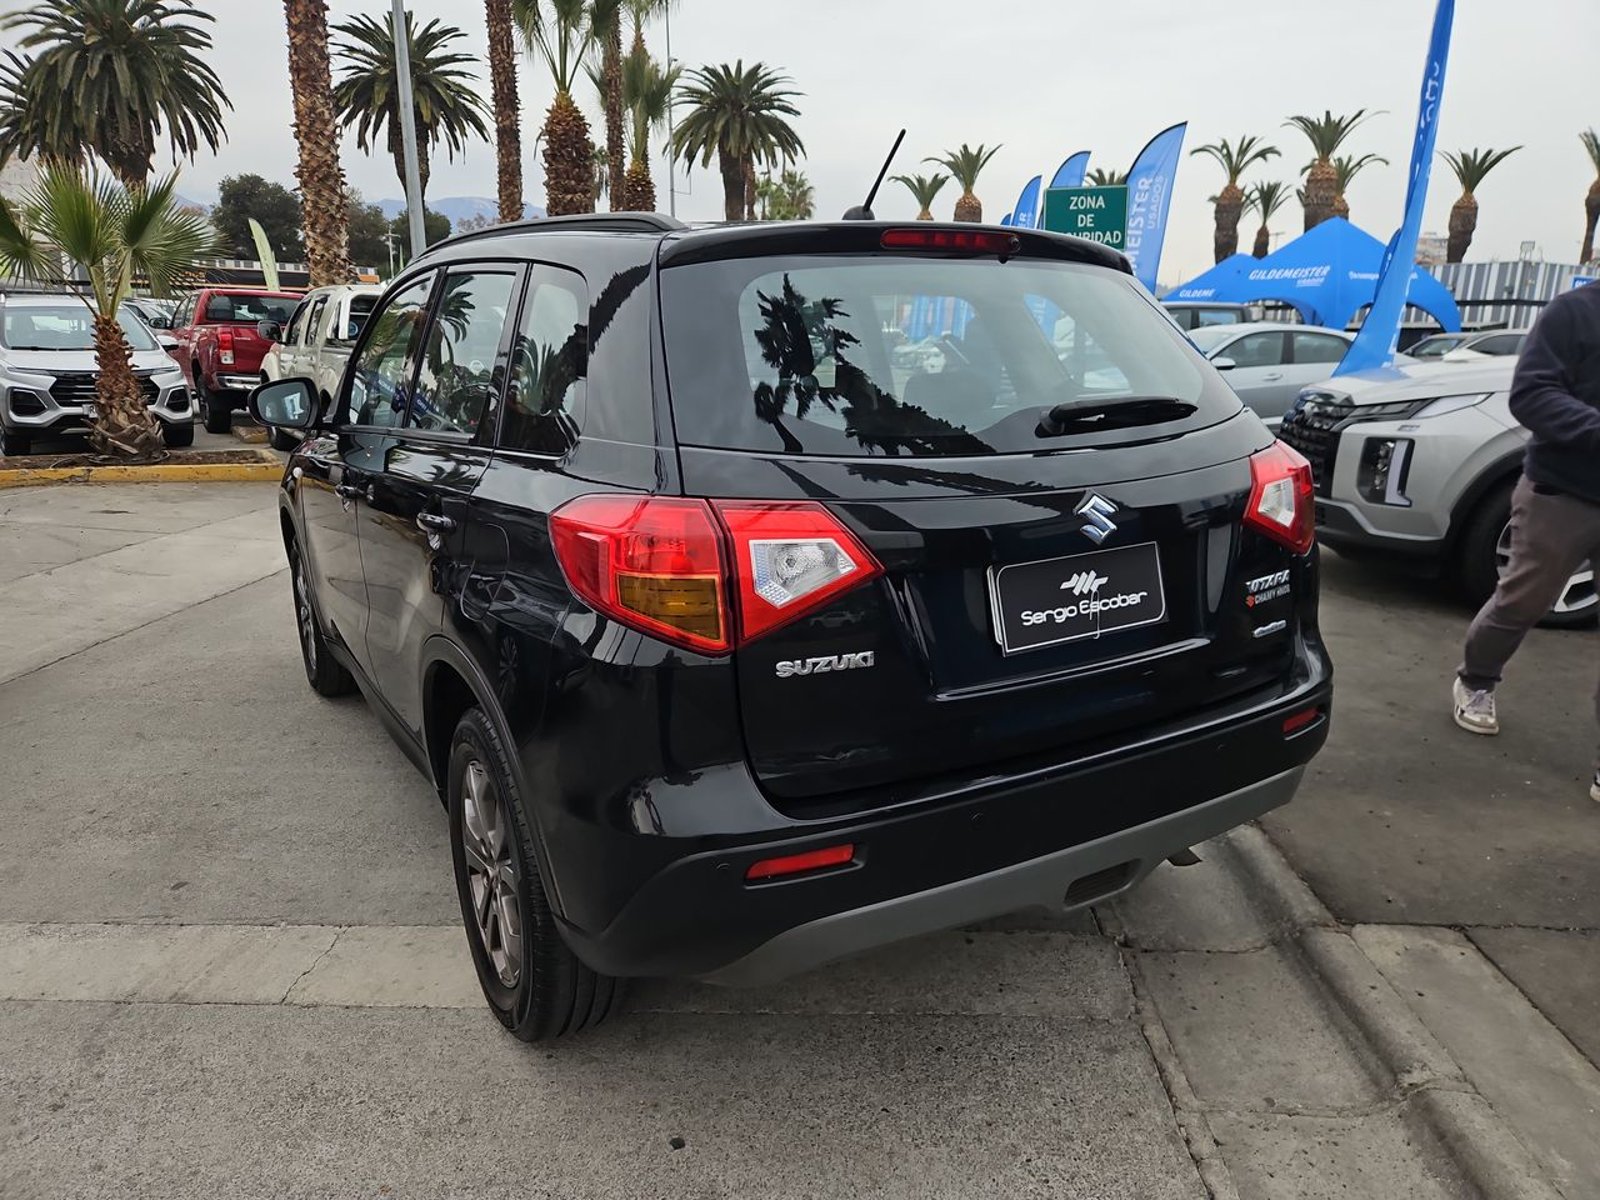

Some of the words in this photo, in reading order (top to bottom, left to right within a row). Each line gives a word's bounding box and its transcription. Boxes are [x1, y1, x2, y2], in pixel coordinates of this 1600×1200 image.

[1069, 195, 1106, 210] ZONA
[1077, 213, 1095, 228] DE
[1126, 177, 1153, 276] MEISTER
[1066, 230, 1122, 244] RIDAD
[1248, 265, 1331, 281] GILDEMEISTER
[1179, 288, 1216, 298] GILDEME
[1079, 591, 1148, 615] Escobar
[775, 650, 874, 678] SUZUKI
